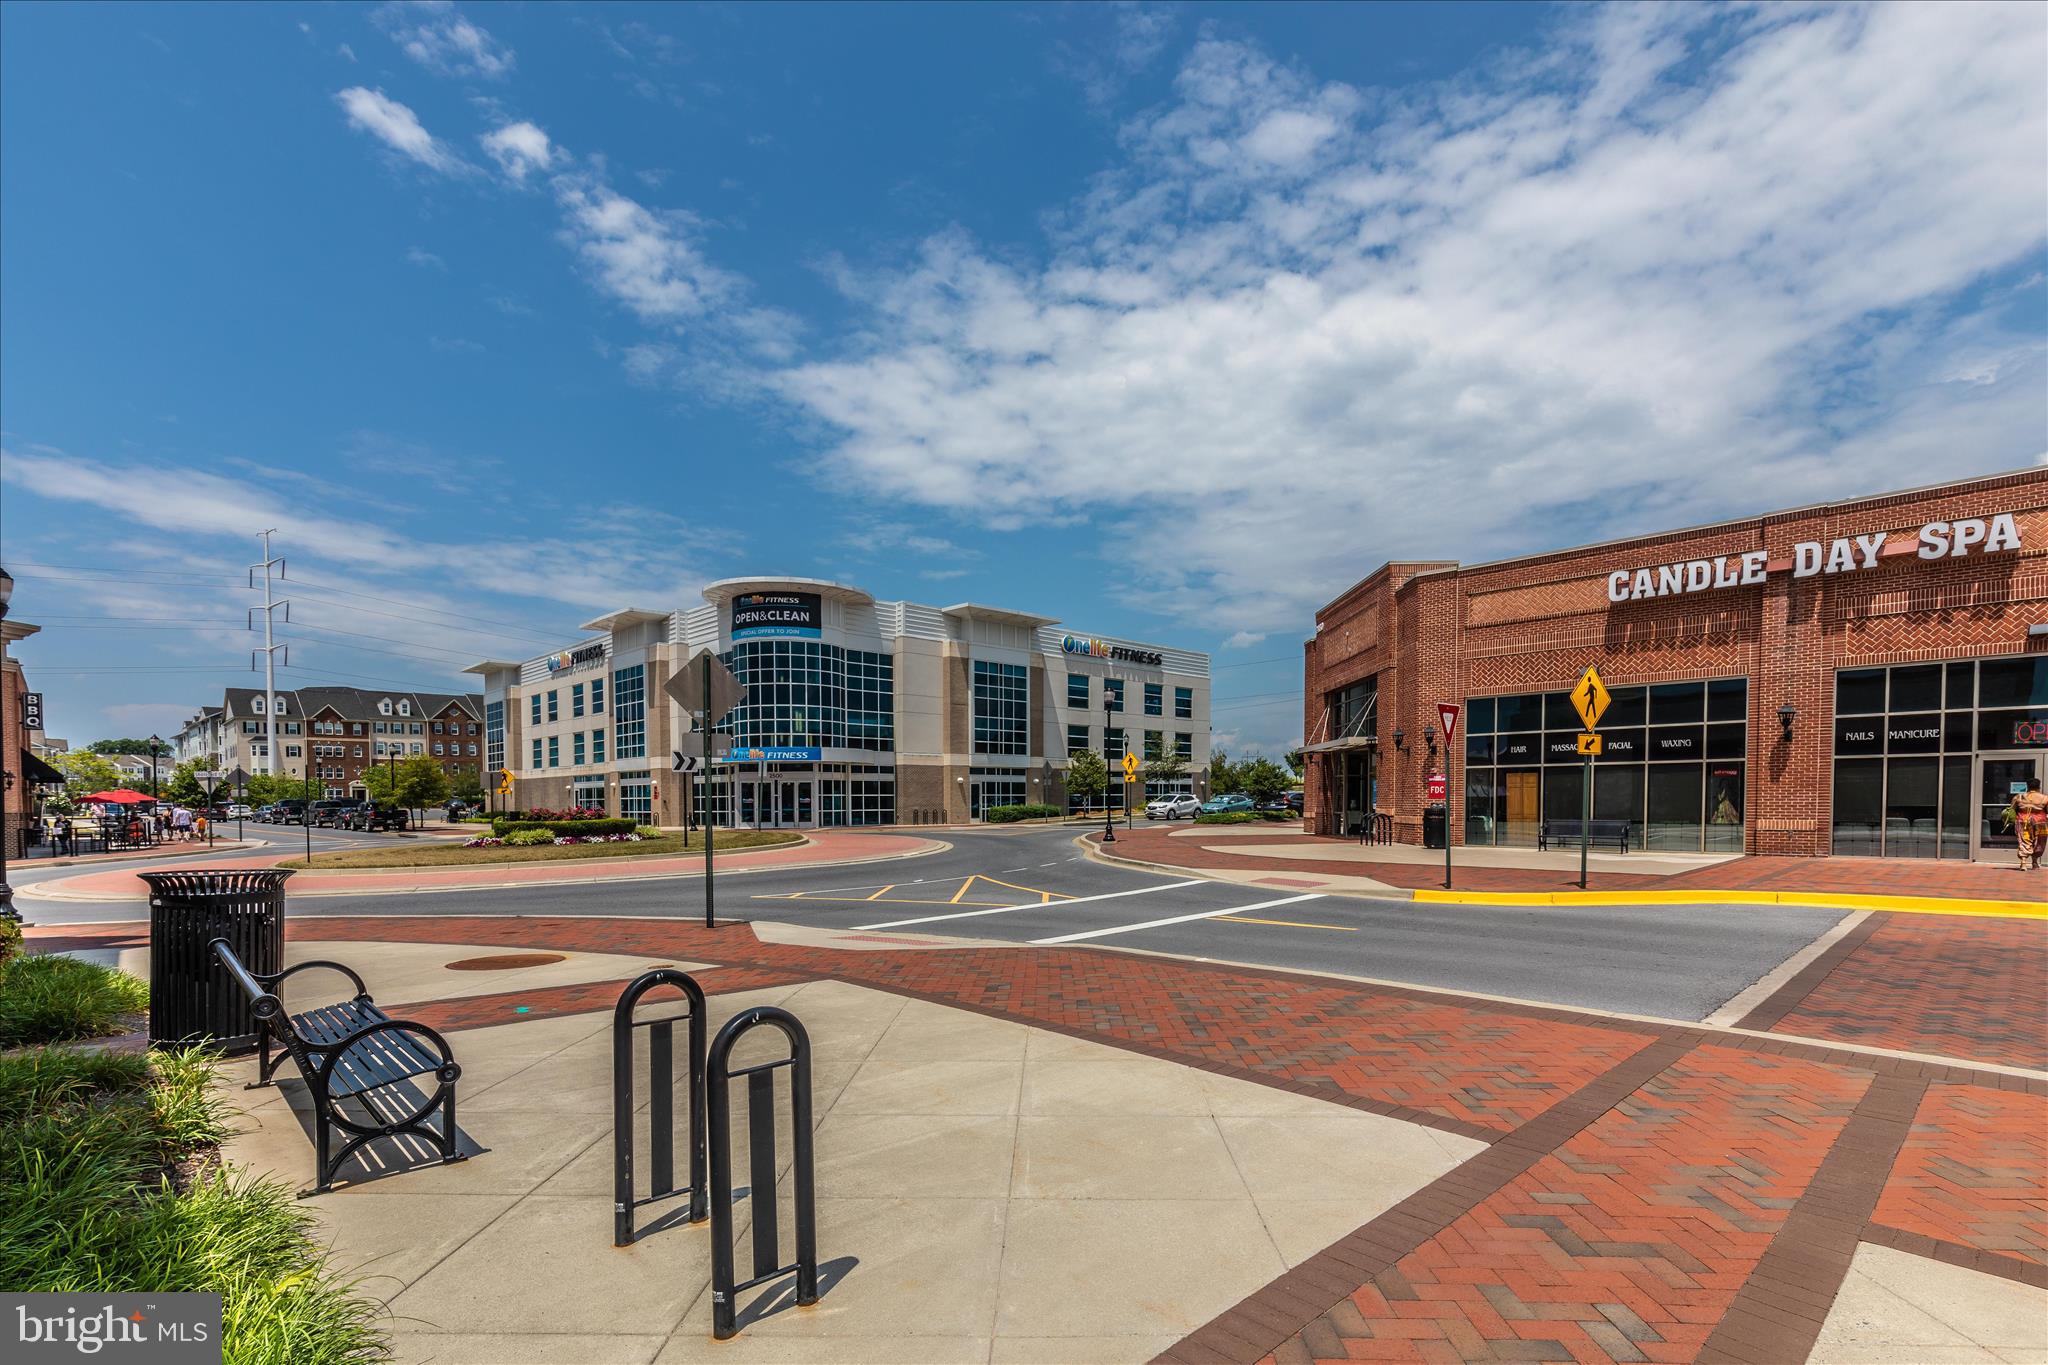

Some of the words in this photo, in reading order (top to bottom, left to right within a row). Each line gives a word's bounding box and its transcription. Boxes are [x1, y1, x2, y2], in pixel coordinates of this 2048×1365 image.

[1608, 550, 1767, 602] CANDLE
[1794, 532, 1887, 578] DAY
[1918, 512, 2022, 560] SPA
[765, 596, 800, 604] FITNESS
[1062, 635, 1110, 657] Onelife
[1110, 646, 1163, 666] FITNESS
[26, 695, 40, 728] BBQ
[1845, 731, 1875, 741] NAILS
[1889, 728, 1940, 740] MANICURE
[1608, 741, 1633, 750] FACIAL
[1661, 738, 1692, 748] WAXING
[1510, 745, 1527, 753] HAIR
[767, 751, 809, 759] FITNESS
[1430, 786, 1445, 794] FDC
